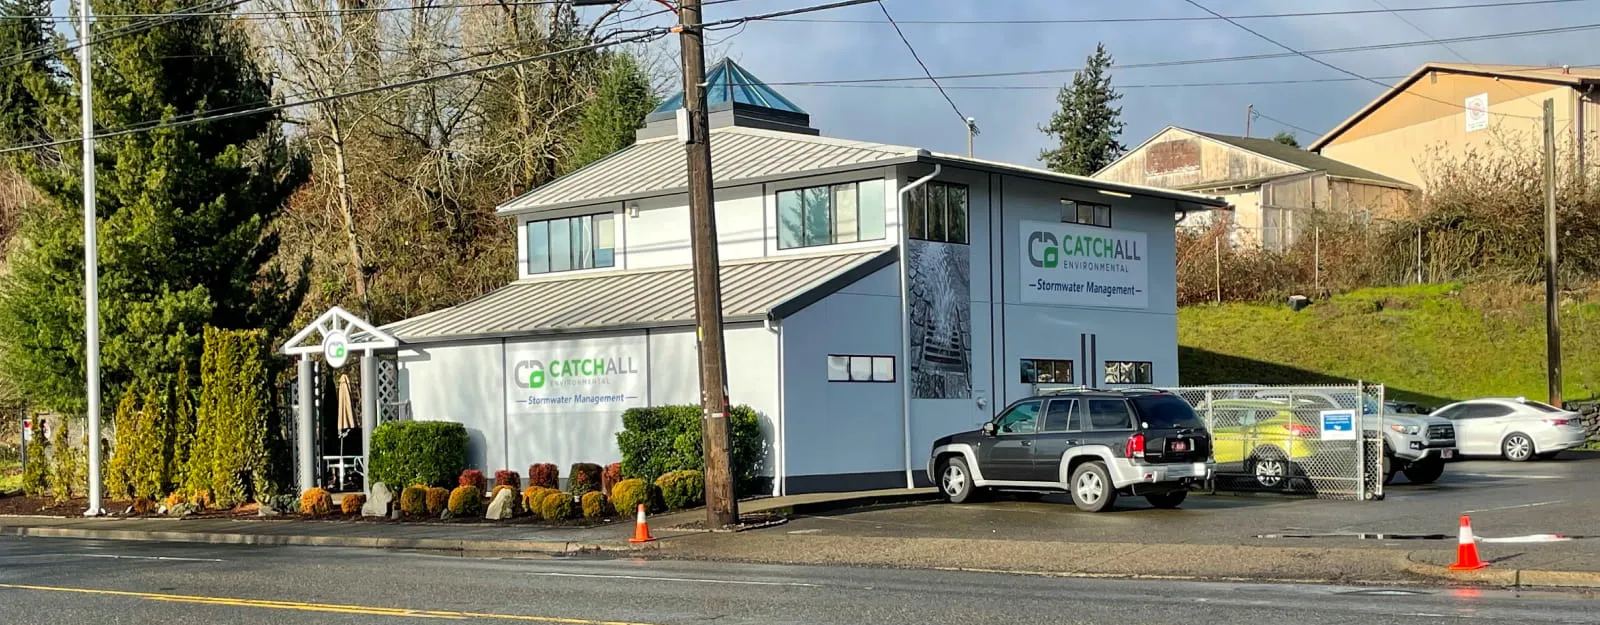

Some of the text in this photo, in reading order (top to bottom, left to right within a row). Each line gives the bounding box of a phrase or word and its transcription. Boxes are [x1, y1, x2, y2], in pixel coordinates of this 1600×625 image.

[1063, 234, 1141, 260] CATCHALL
[1063, 260, 1129, 273] ENVIRONMENTAL
[1037, 278, 1135, 297] Stormwater Management
[549, 357, 638, 377] CATCHALL
[550, 378, 611, 387] ENVIRONMENTAL
[528, 394, 624, 405] Stormwater Management
